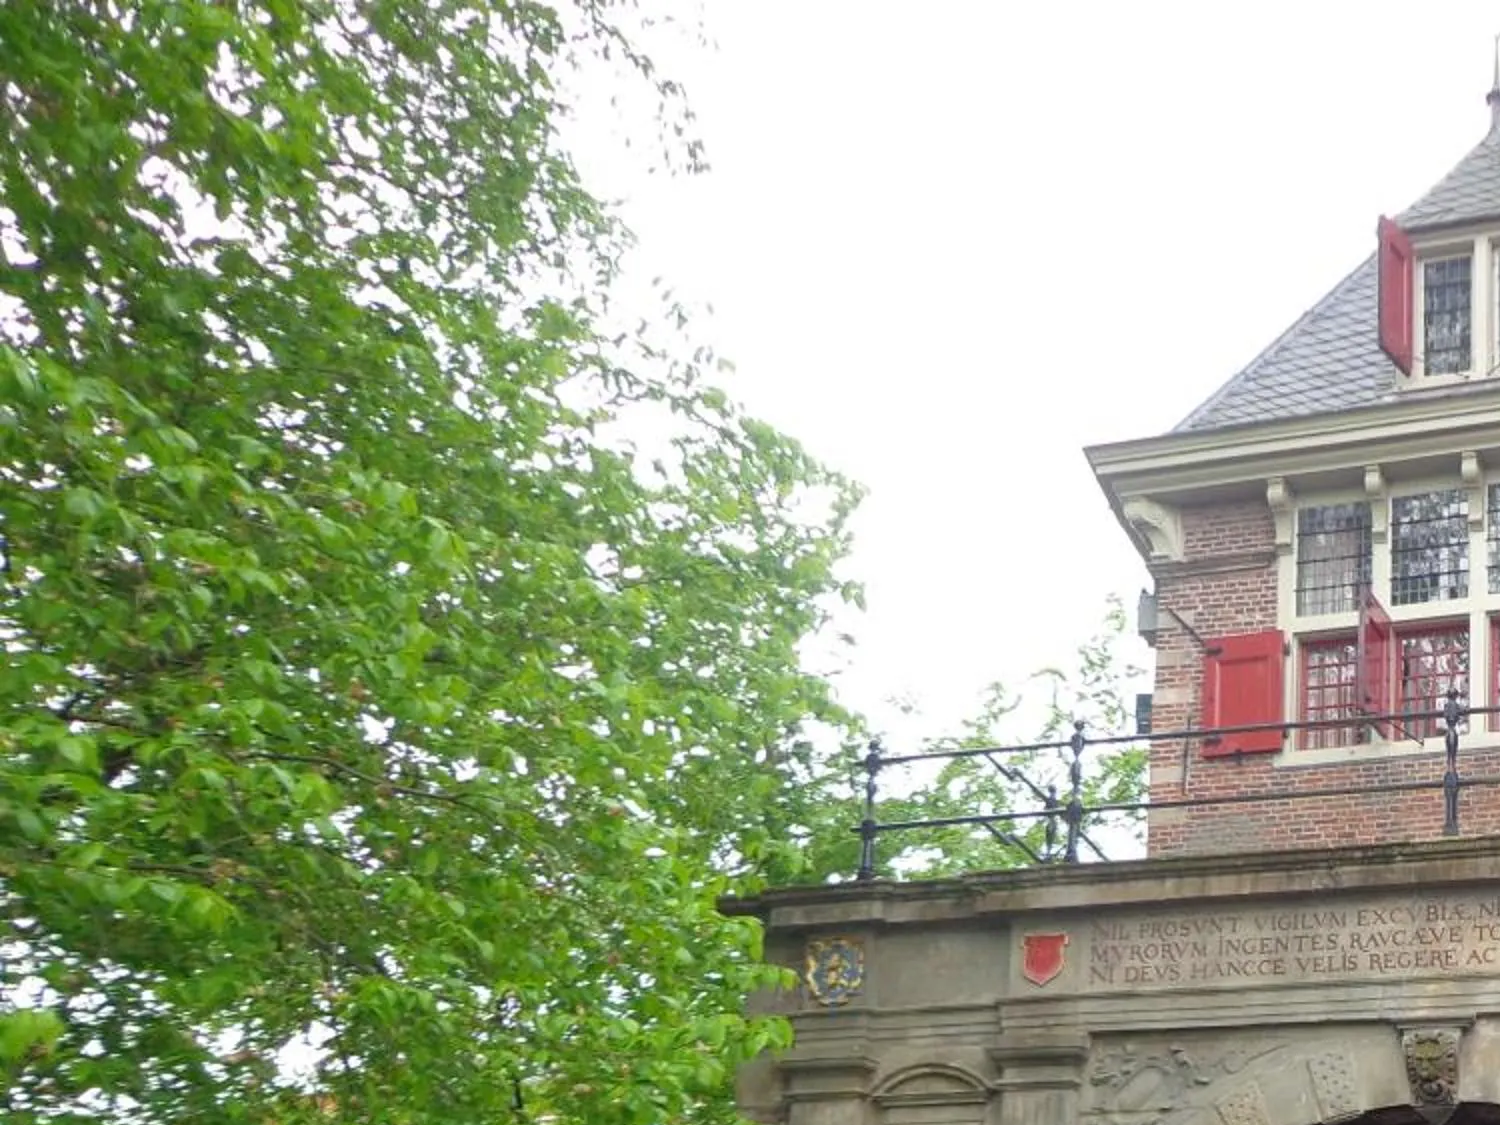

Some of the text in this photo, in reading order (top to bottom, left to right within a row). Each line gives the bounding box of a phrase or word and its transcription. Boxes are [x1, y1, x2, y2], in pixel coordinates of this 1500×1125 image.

[1139, 917, 1241, 941] PROSVNT
[1253, 910, 1347, 932] VIGILVM
[1089, 942, 1207, 964] MVRORVM
[1124, 964, 1181, 983] DEVS
[1294, 951, 1358, 975] VELIS
[1368, 949, 1458, 974] REGERE
[1465, 947, 1496, 966] AC
